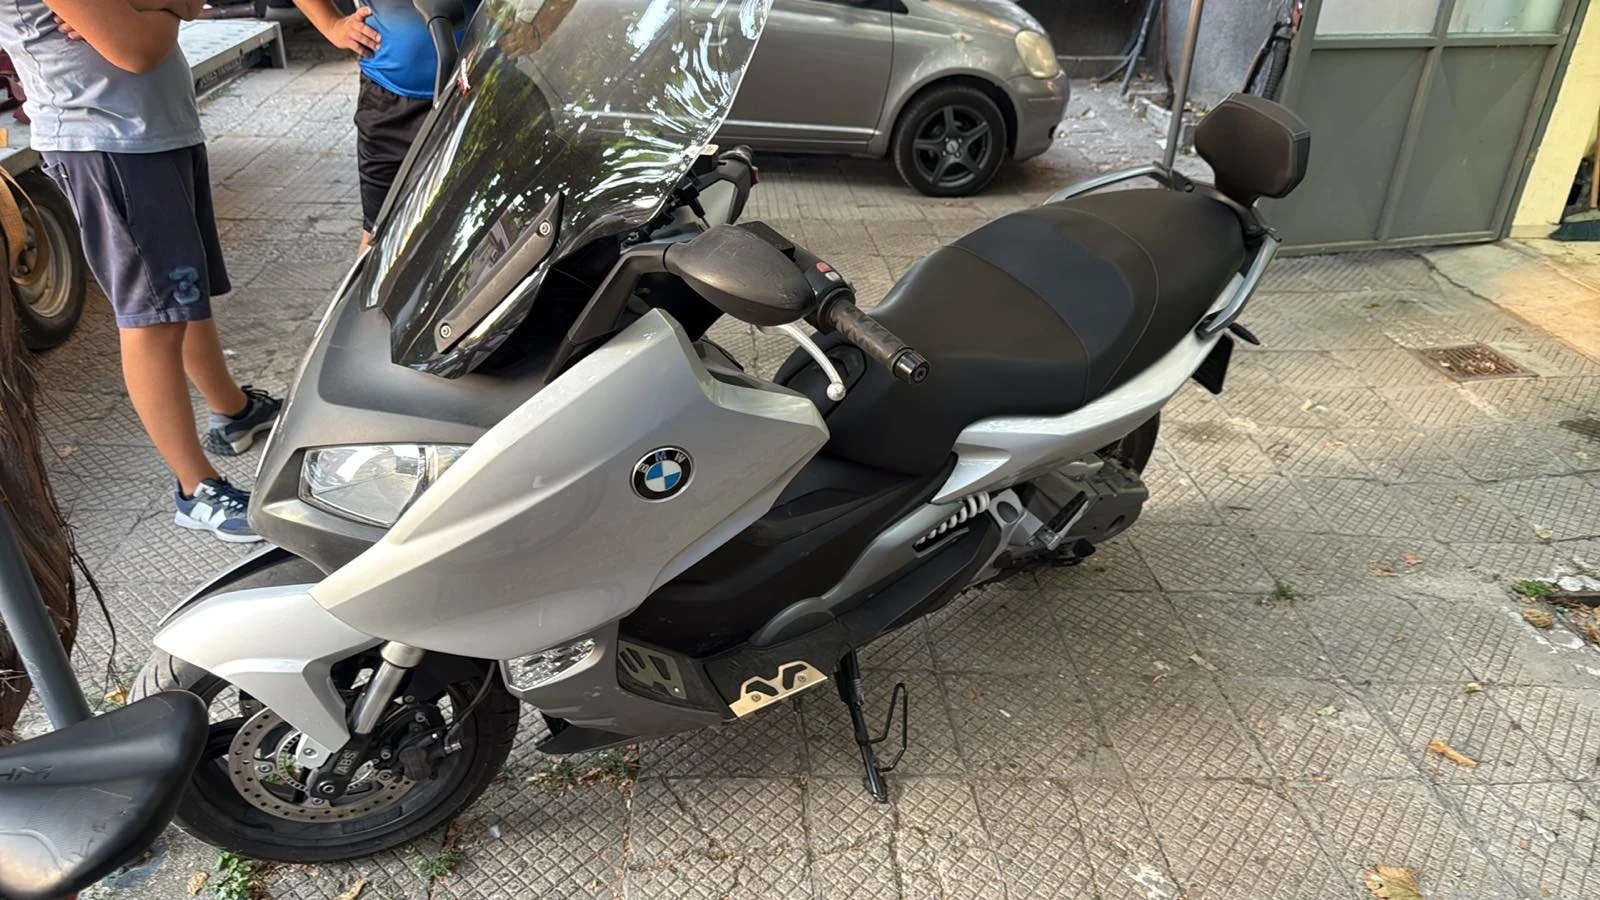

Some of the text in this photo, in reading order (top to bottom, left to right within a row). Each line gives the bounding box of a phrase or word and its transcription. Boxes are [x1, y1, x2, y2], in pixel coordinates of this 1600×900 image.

[168, 266, 200, 304] 3
[637, 450, 687, 473] BMW
[335, 752, 356, 774] ABS
